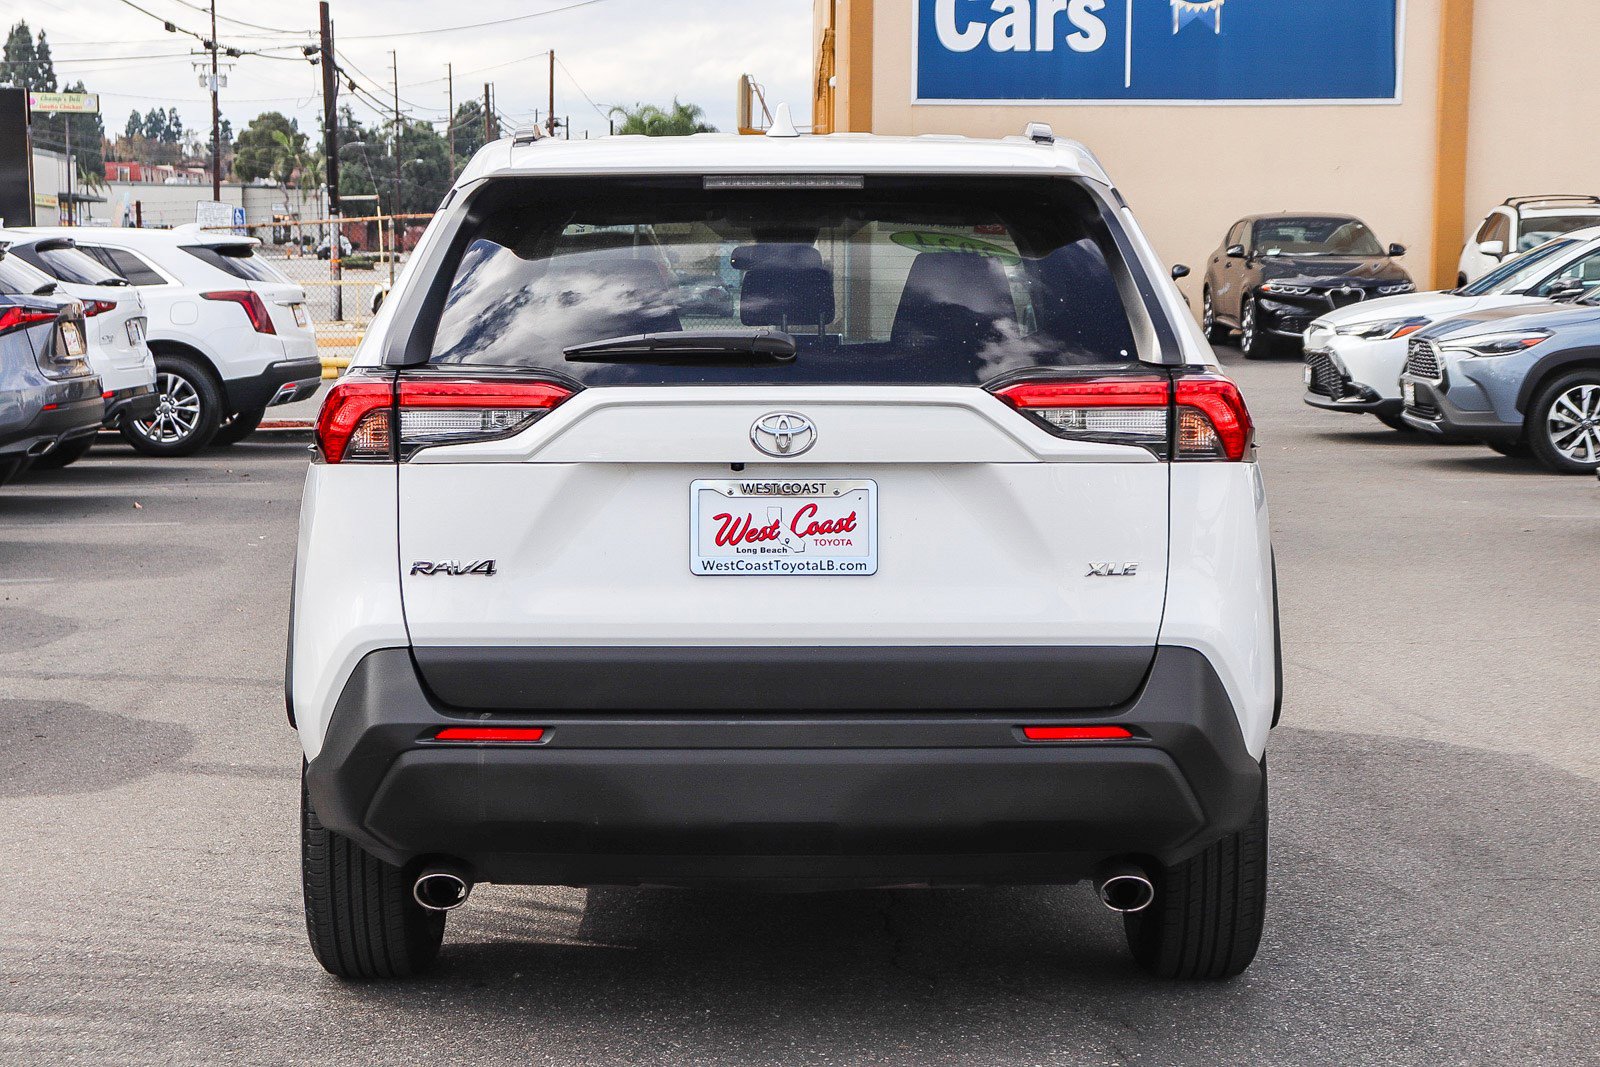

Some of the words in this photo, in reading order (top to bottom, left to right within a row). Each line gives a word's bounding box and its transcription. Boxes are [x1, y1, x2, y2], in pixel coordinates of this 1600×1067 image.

[934, 0, 1107, 53] Cars
[740, 482, 780, 495] WEST
[780, 482, 827, 495] COAST
[712, 512, 781, 547] West
[790, 503, 858, 538] Coast
[813, 538, 853, 547] TOYOTA
[736, 546, 758, 555] Long
[760, 546, 788, 554] Beach
[410, 559, 497, 577] RAV4
[701, 559, 867, 574] WestCoastToyotaLB.com
[1084, 561, 1139, 577] XLE
